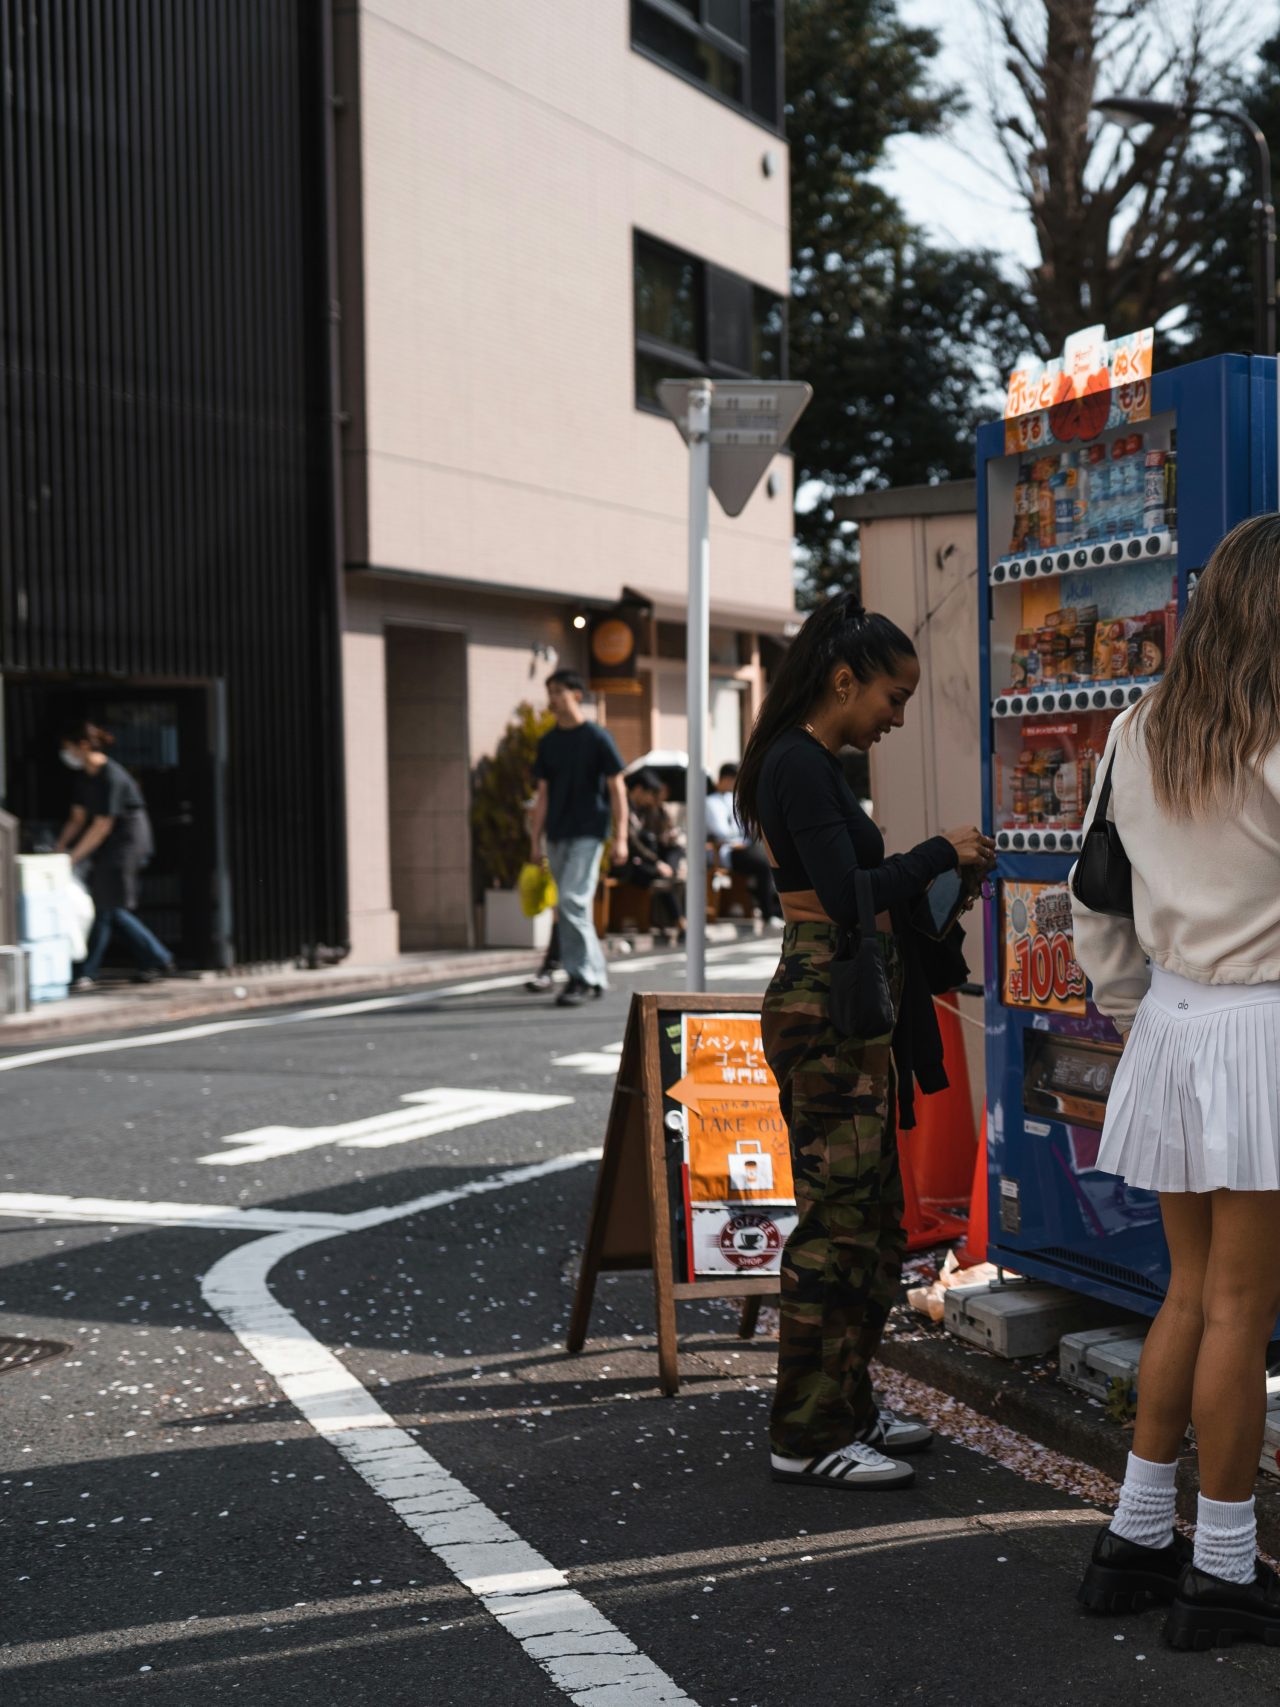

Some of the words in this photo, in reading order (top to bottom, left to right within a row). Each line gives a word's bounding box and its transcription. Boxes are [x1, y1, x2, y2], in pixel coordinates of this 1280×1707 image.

[1113, 349, 1141, 378] ぬく
[1009, 375, 1052, 414] ホッと
[1119, 381, 1147, 411] もり
[1018, 415, 1042, 444] する
[1009, 930, 1073, 1001] ¥100
[714, 1052, 767, 1068] コーヒ
[721, 1067, 768, 1085] 専門店
[699, 1117, 746, 1133] TAKE
[758, 1117, 784, 1133] OU
[726, 1214, 775, 1236] COFFEE
[738, 1254, 764, 1268] SHOP
